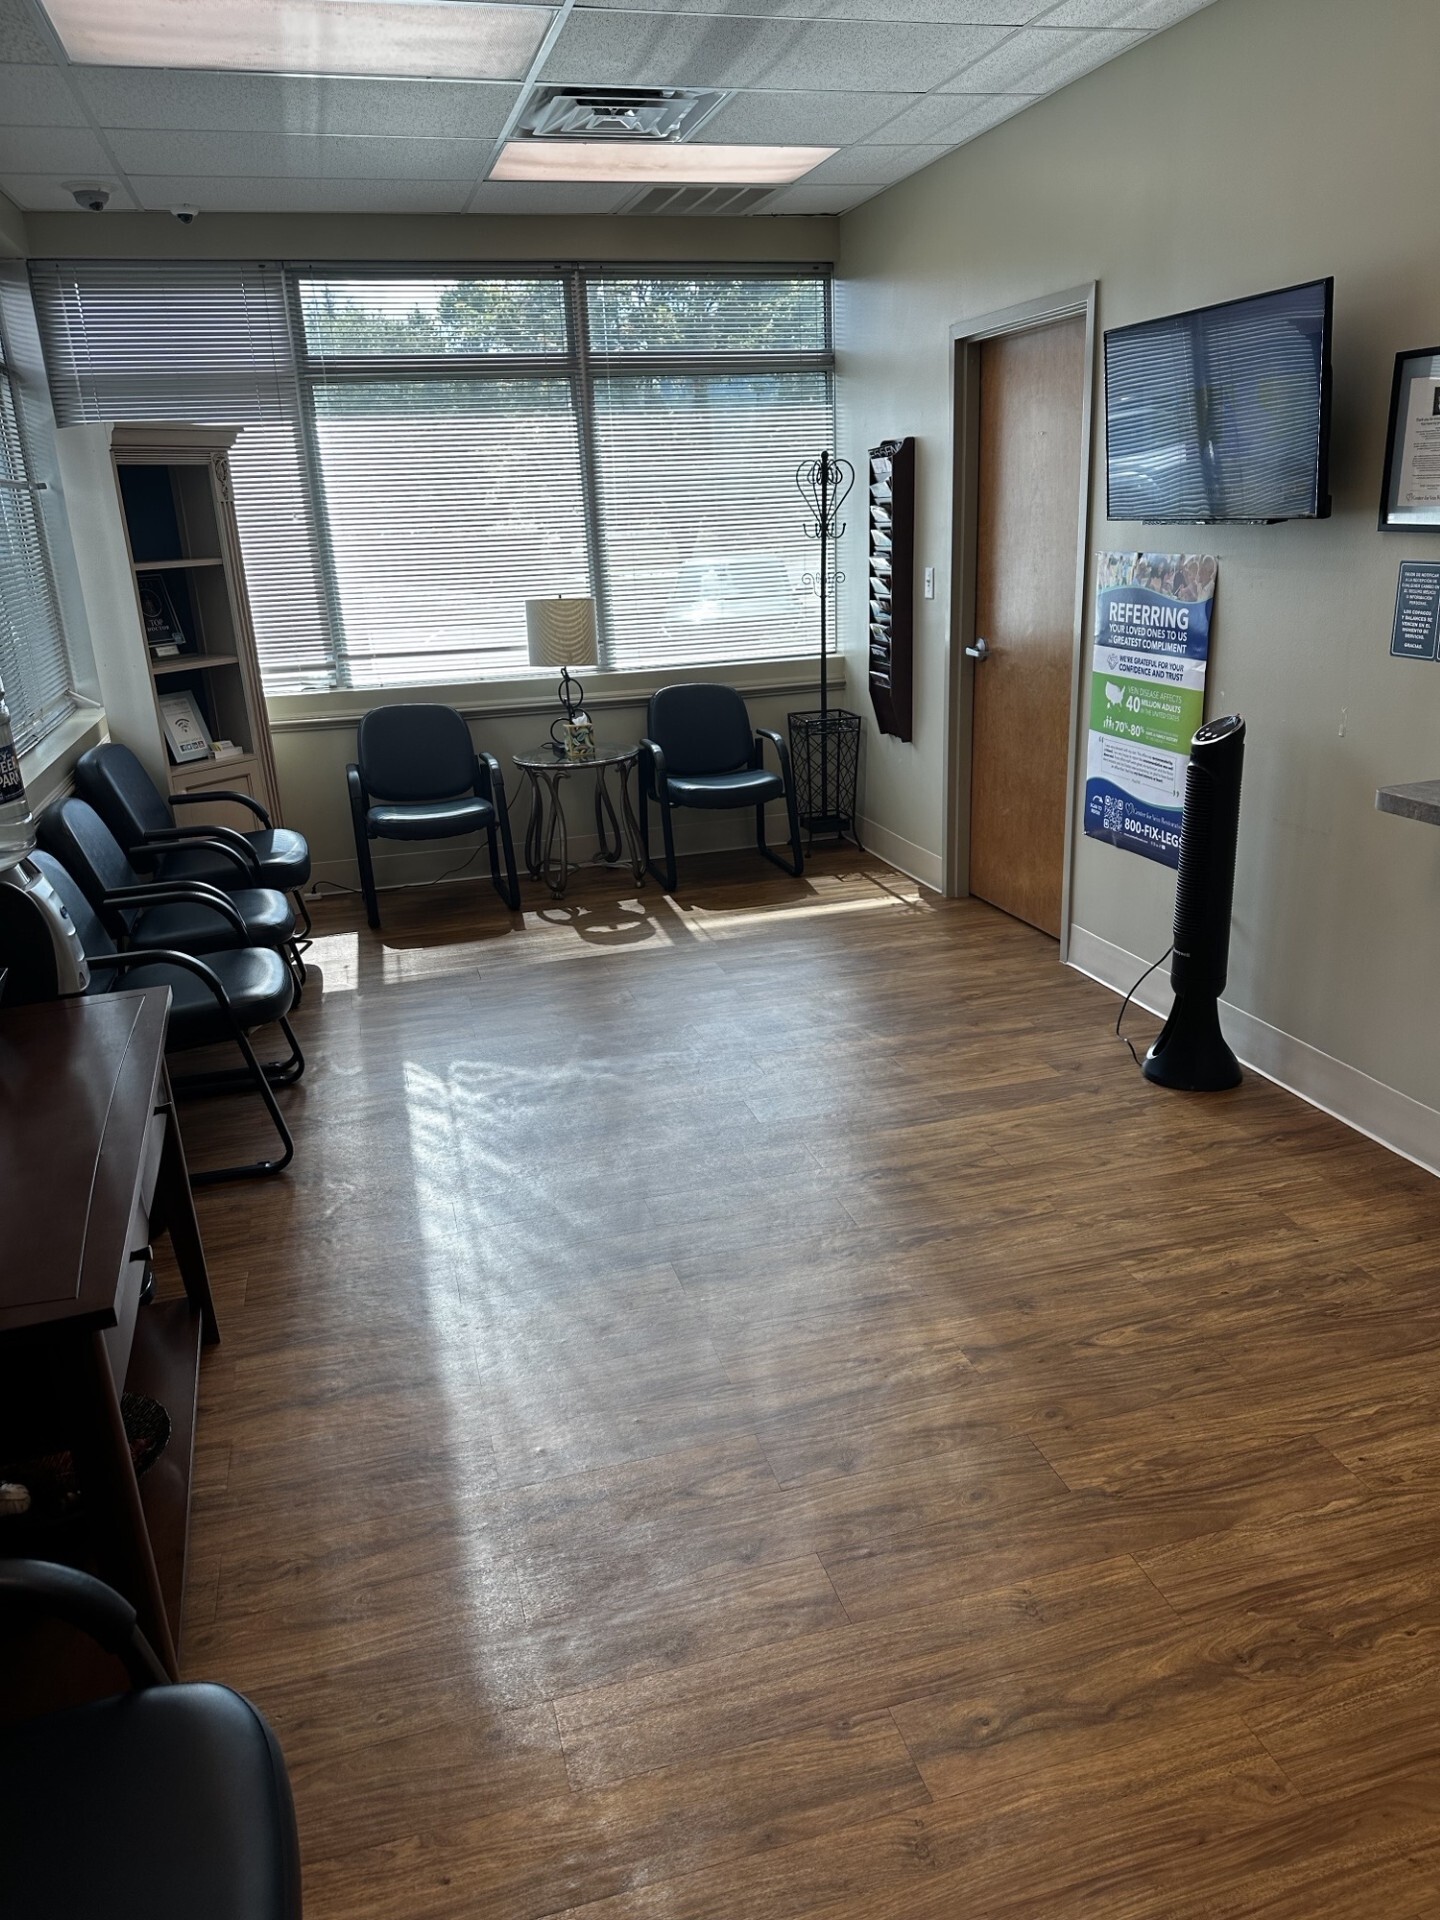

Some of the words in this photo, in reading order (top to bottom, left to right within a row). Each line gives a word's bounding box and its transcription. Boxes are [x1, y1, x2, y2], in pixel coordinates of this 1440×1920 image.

[1109, 601, 1189, 630] REFERRING
[1110, 623, 1125, 634] YOUR
[1125, 625, 1146, 636] LOVED
[1146, 628, 1166, 639] ONES
[1166, 630, 1177, 641] TO
[1177, 631, 1188, 642] US
[1113, 635, 1142, 648] GREATEST
[1142, 639, 1188, 654] COMPLIMENT
[1119, 663, 1151, 676] CONFIDENCE
[1151, 669, 1165, 679] AND
[1165, 671, 1184, 682] TRUST
[1134, 657, 1158, 668] GRATEFUL
[1158, 660, 1169, 669] FOR
[1169, 662, 1185, 672] YOUR
[1126, 695, 1141, 713] 40
[1141, 699, 1161, 710] MILLION
[1161, 703, 1182, 714] ADULTS
[1128, 685, 1140, 695] VEIN
[1139, 687, 1159, 700] DISEASE
[1159, 692, 1182, 705] AFFECTS
